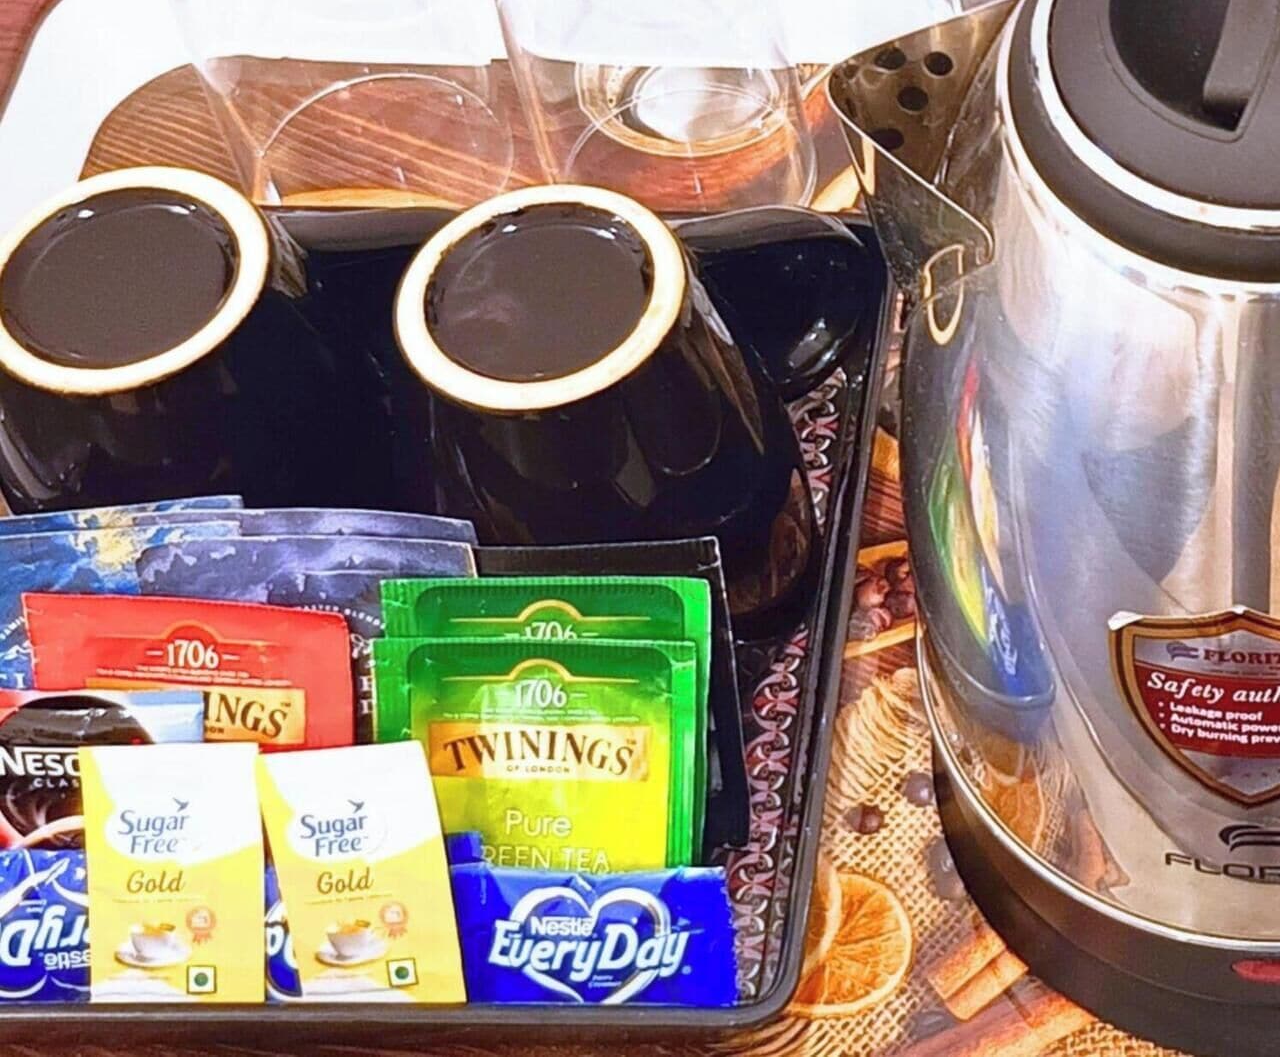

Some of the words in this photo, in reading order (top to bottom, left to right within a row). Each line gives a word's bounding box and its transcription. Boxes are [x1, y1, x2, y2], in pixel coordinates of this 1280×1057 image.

[167, 639, 219, 668] 1706
[514, 678, 568, 708] 1706
[1146, 671, 1225, 705] Safety
[1169, 700, 1223, 719] Leakage
[1225, 710, 1264, 722] proof
[1169, 712, 1239, 732] Automatic
[1170, 723, 1194, 739] Dry
[1196, 727, 1249, 744] burning
[443, 729, 635, 777] TWININGS
[525, 765, 571, 773] LONDON
[117, 808, 191, 837] Sugar
[299, 814, 369, 840] Sugar
[505, 808, 572, 837] Pure
[129, 834, 179, 854] Free
[314, 836, 364, 857] Free
[482, 845, 552, 869] REEN
[561, 846, 611, 874] TEA
[126, 868, 187, 894] Gold
[316, 865, 375, 895] Gold
[488, 919, 691, 982] EveryDay
